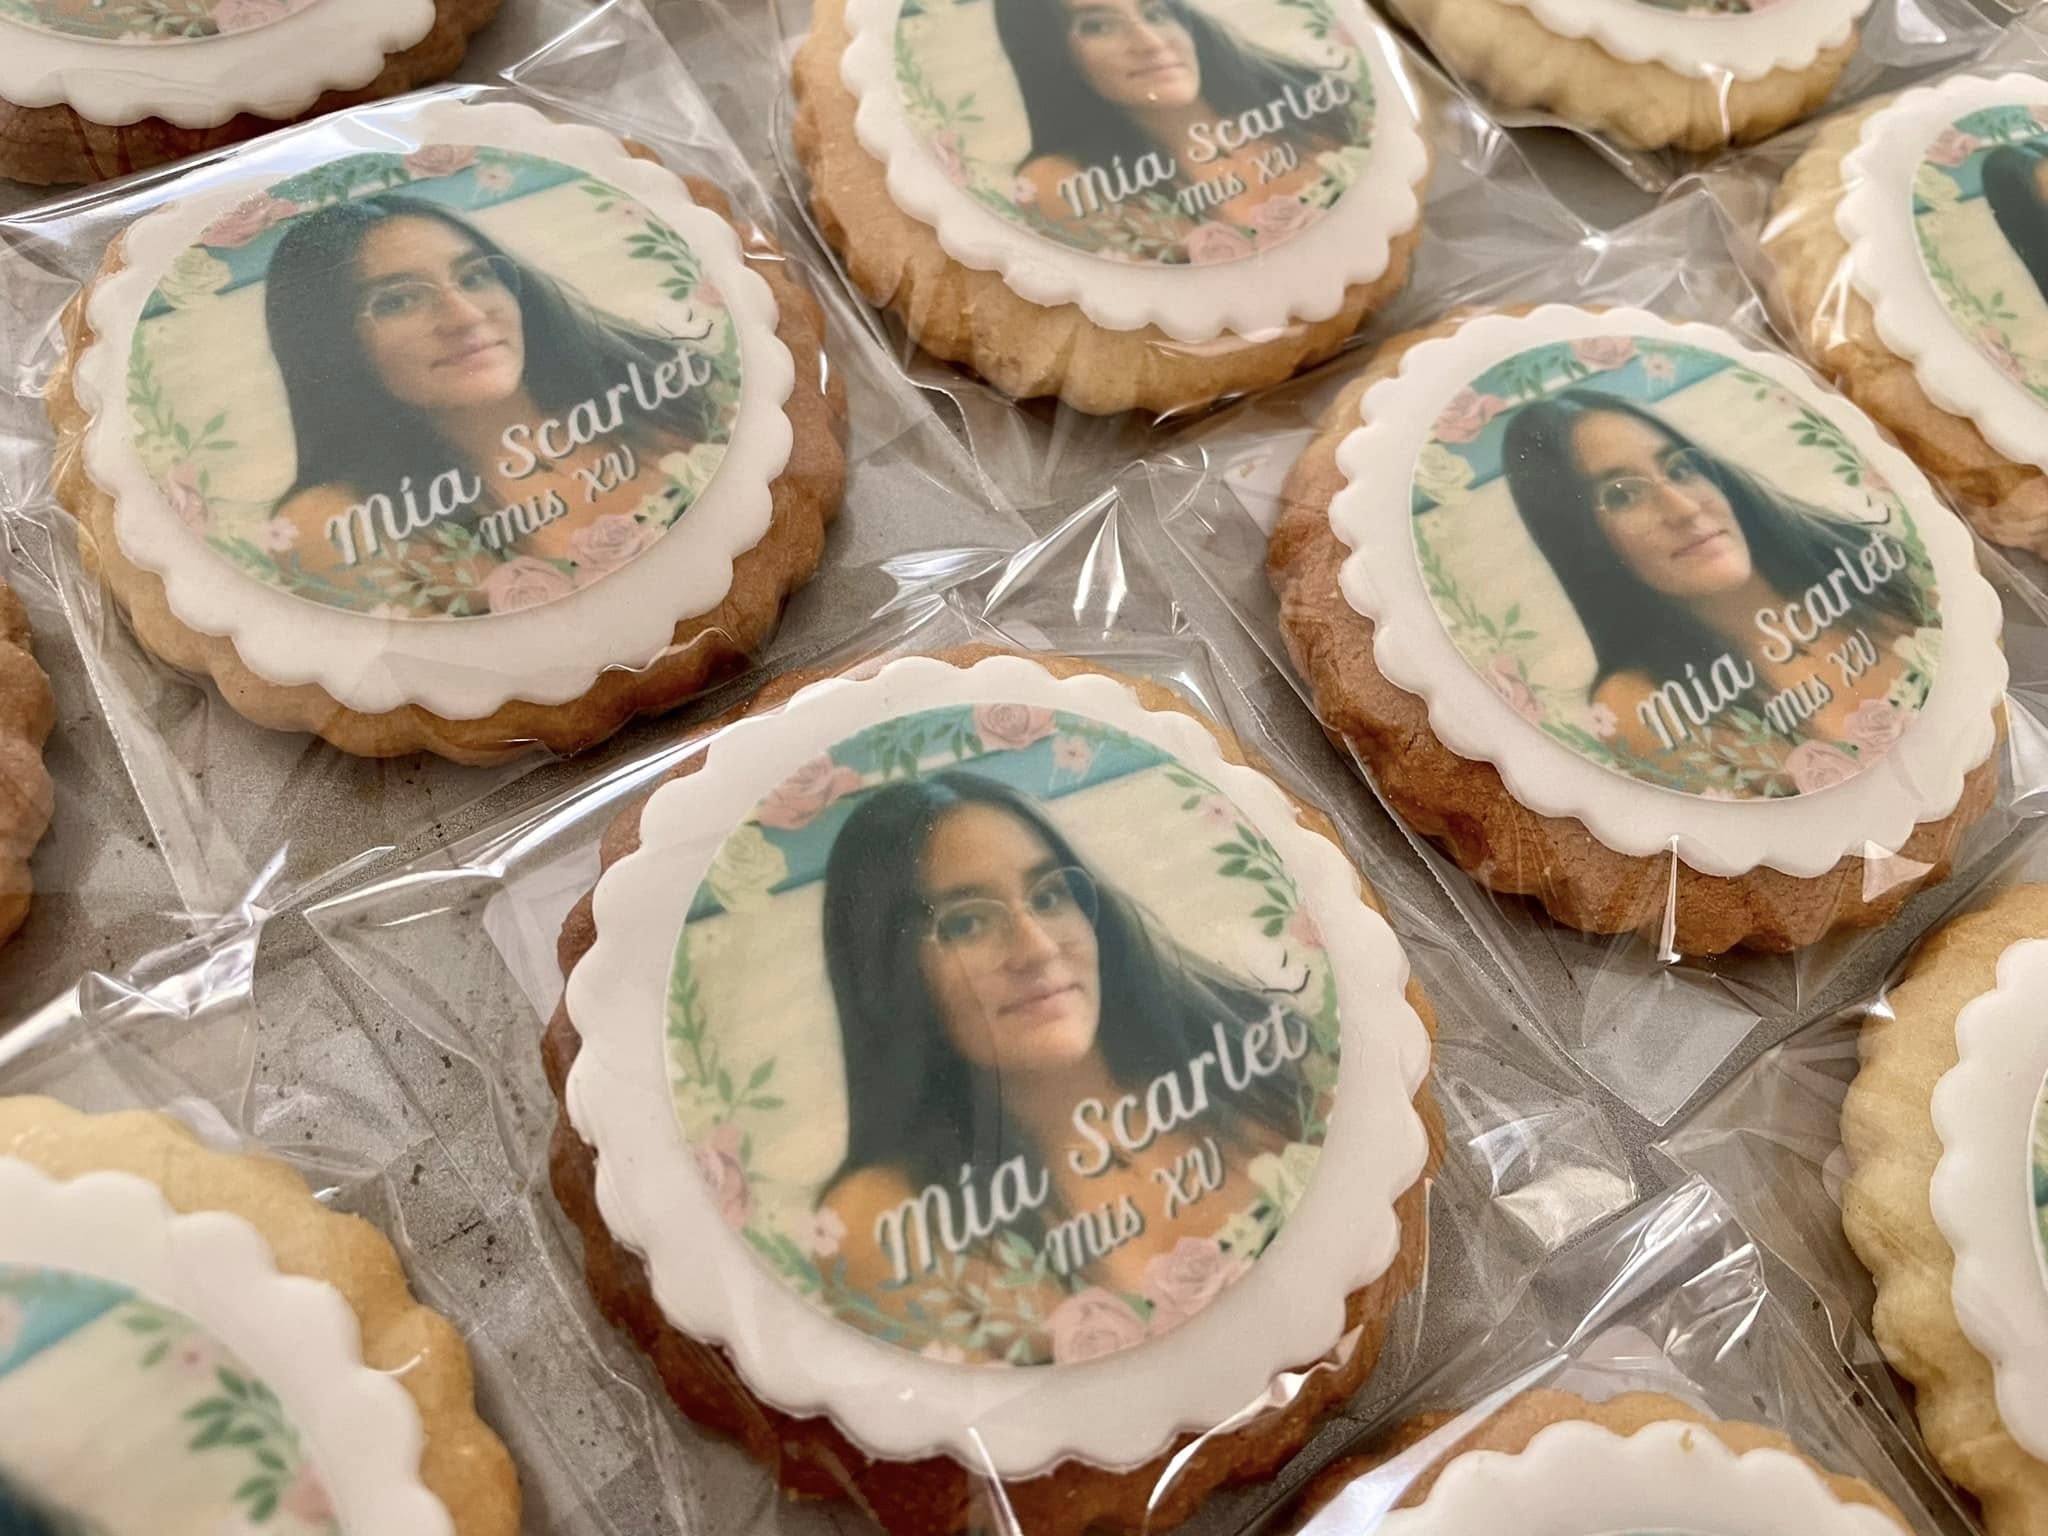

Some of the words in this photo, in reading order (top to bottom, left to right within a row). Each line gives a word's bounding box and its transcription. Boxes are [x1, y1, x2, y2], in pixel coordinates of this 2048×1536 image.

[1188, 74, 1351, 164] Scarlet
[1250, 142, 1299, 184] XV
[500, 345, 712, 480] Scarlet
[573, 443, 641, 502] XV
[1754, 531, 1908, 664] Scarlet
[1826, 628, 1880, 688] XV
[1067, 1003, 1309, 1178] Scarlet
[1150, 1137, 1224, 1220] XV
